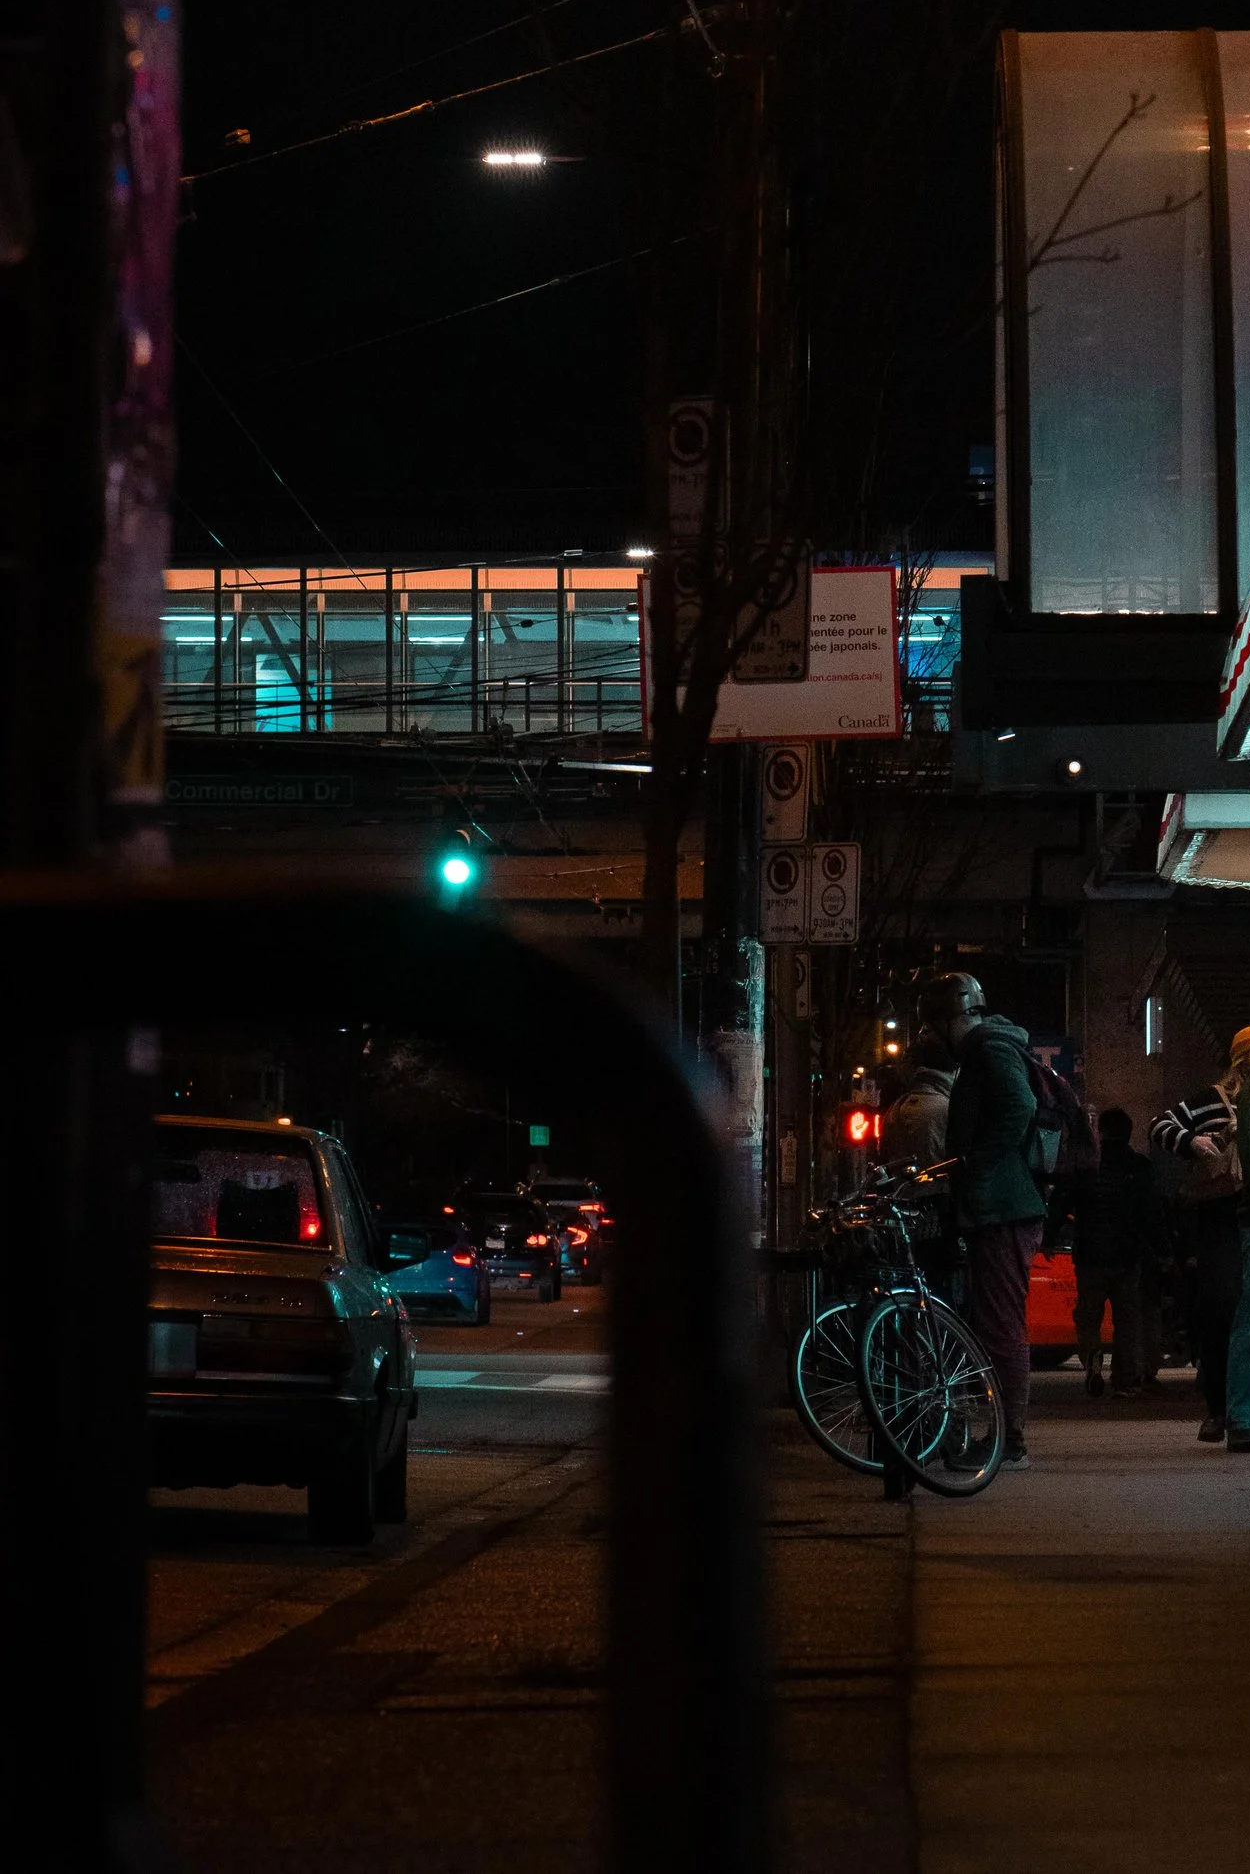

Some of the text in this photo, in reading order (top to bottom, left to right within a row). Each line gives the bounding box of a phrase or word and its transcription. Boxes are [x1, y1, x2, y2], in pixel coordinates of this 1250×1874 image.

[810, 613, 857, 623] ne zone
[847, 628, 875, 639] pour
[877, 625, 888, 636] le
[829, 640, 882, 654] japonais.
[838, 714, 890, 729] Canada
[166, 779, 340, 802] Commercial Dr
